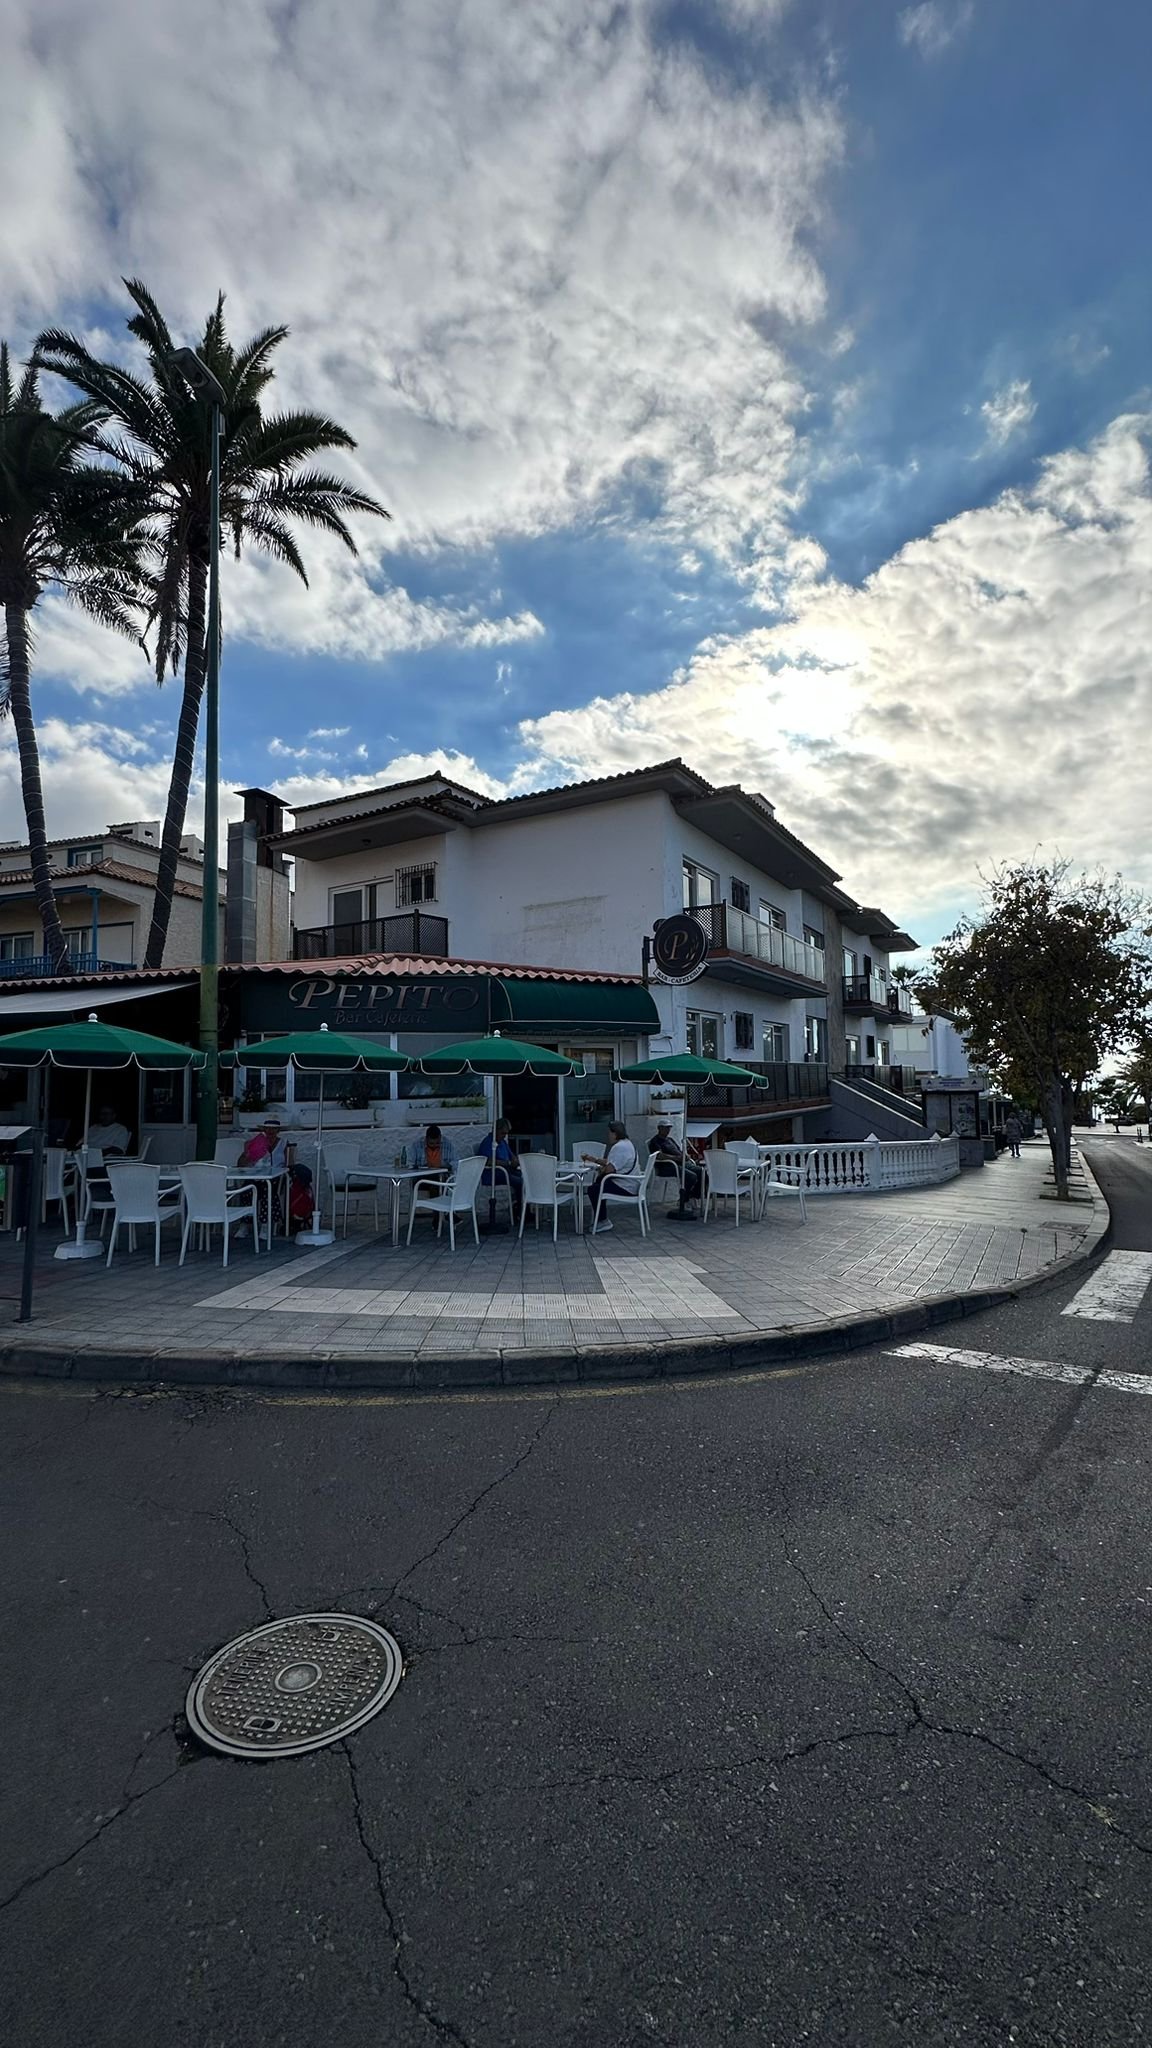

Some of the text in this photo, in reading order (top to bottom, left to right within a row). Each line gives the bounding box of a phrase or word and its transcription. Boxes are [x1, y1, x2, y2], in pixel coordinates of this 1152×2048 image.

[657, 971, 668, 981] BAR
[289, 978, 479, 1010] PEPITO
[335, 1010, 360, 1025] Bar
[216, 1646, 269, 1695] TENERIFE
